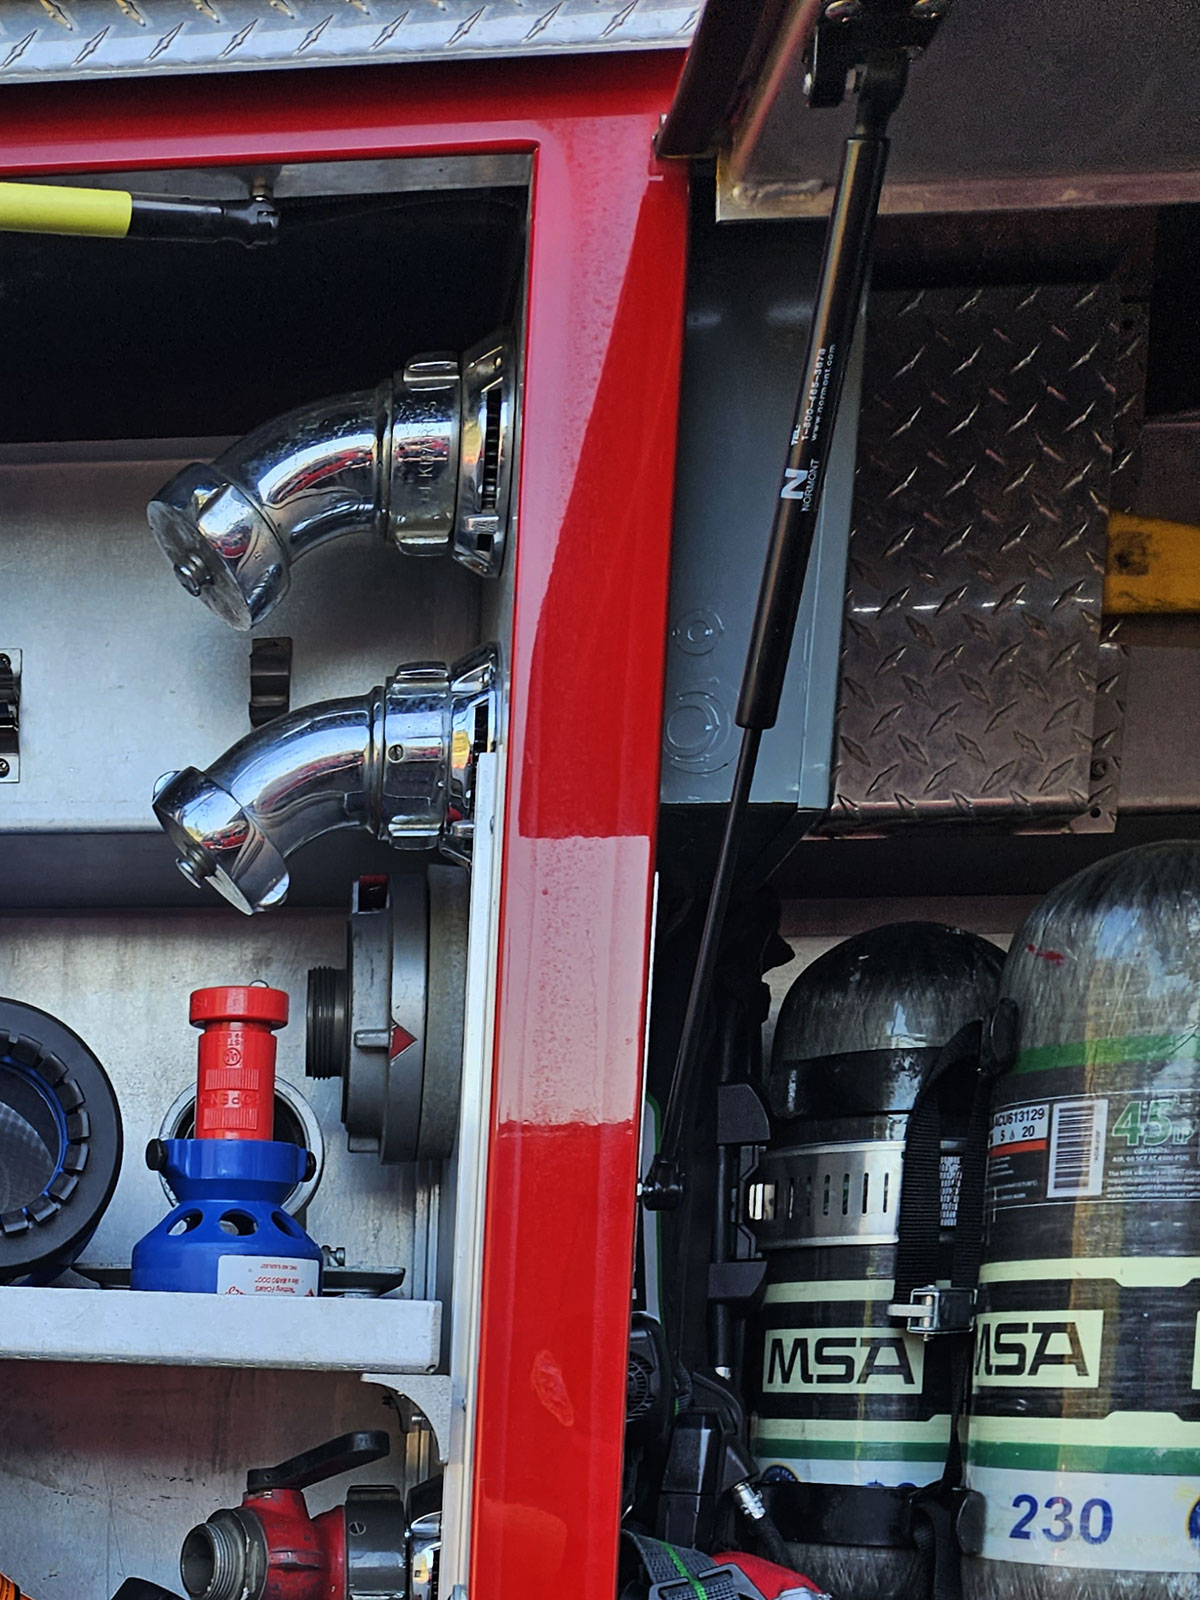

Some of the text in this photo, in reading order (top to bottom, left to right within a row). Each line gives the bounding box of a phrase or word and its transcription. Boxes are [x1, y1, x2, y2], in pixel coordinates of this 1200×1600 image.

[780, 467, 809, 500] N
[800, 458, 820, 512] NORMONT
[1021, 1124, 1036, 1138] 20
[1111, 1100, 1174, 1146] 45
[766, 1337, 916, 1386] MSA
[1008, 1493, 1113, 1546] 230
